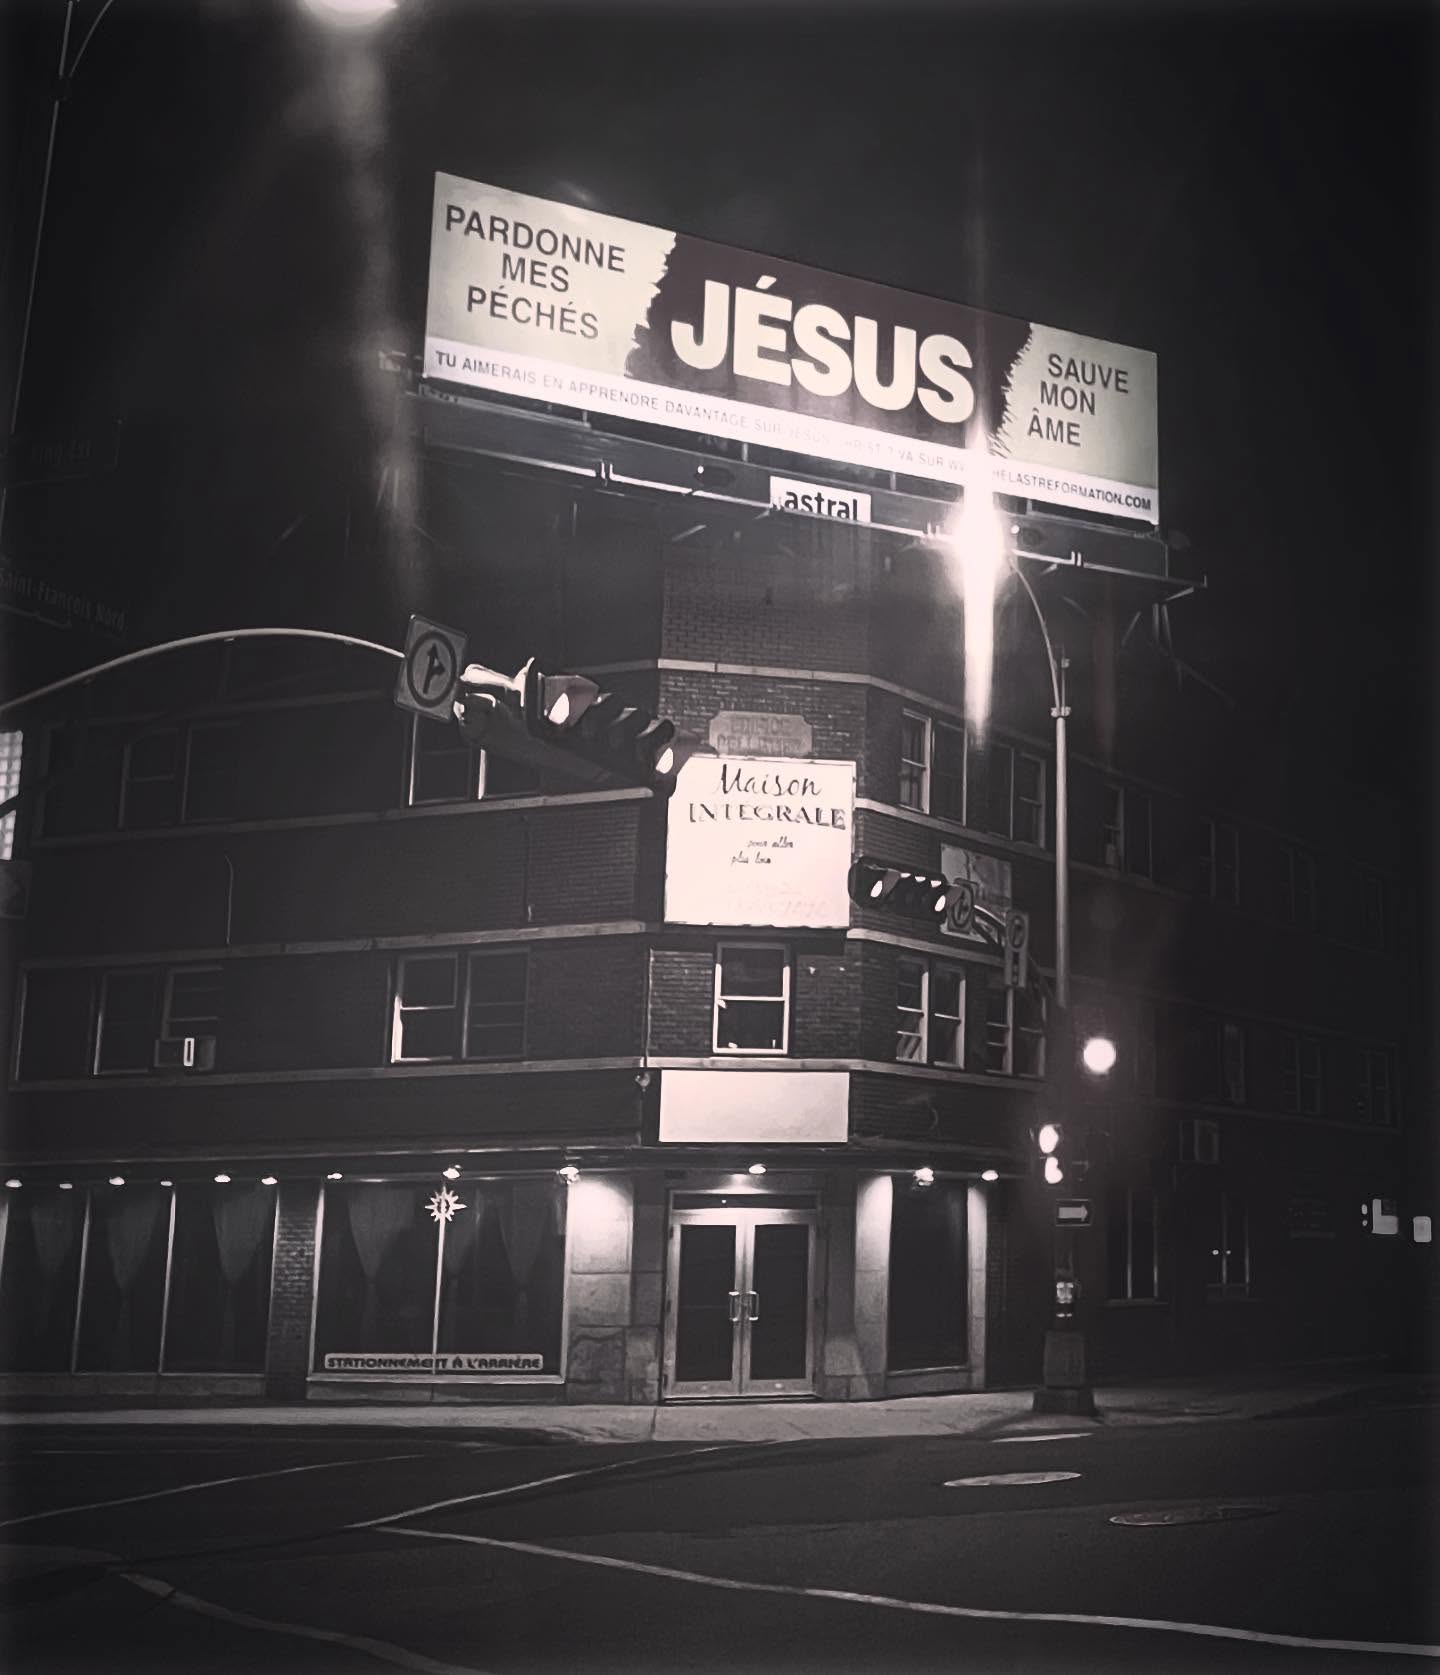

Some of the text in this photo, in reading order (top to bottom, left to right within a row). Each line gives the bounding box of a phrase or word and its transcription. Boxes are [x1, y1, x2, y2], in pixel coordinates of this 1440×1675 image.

[445, 204, 626, 273] PARDONNE
[501, 252, 570, 293] MES
[466, 285, 599, 340] PÉCHÉS
[670, 275, 976, 424] JÉSUS
[1047, 353, 1129, 394] SAUVE
[435, 350, 457, 368] TU
[461, 356, 538, 385] AIMERAIS
[542, 374, 563, 391] EN
[568, 380, 660, 411] APPRENDRE
[753, 418, 783, 435] SUR
[898, 450, 914, 462] VA
[918, 452, 945, 467] SUR
[1039, 380, 1097, 416] MON
[1027, 407, 1082, 447] ÂME
[784, 491, 858, 521] astral
[718, 763, 823, 796] Maison
[327, 1358, 448, 1369] STATIONNEMENT
